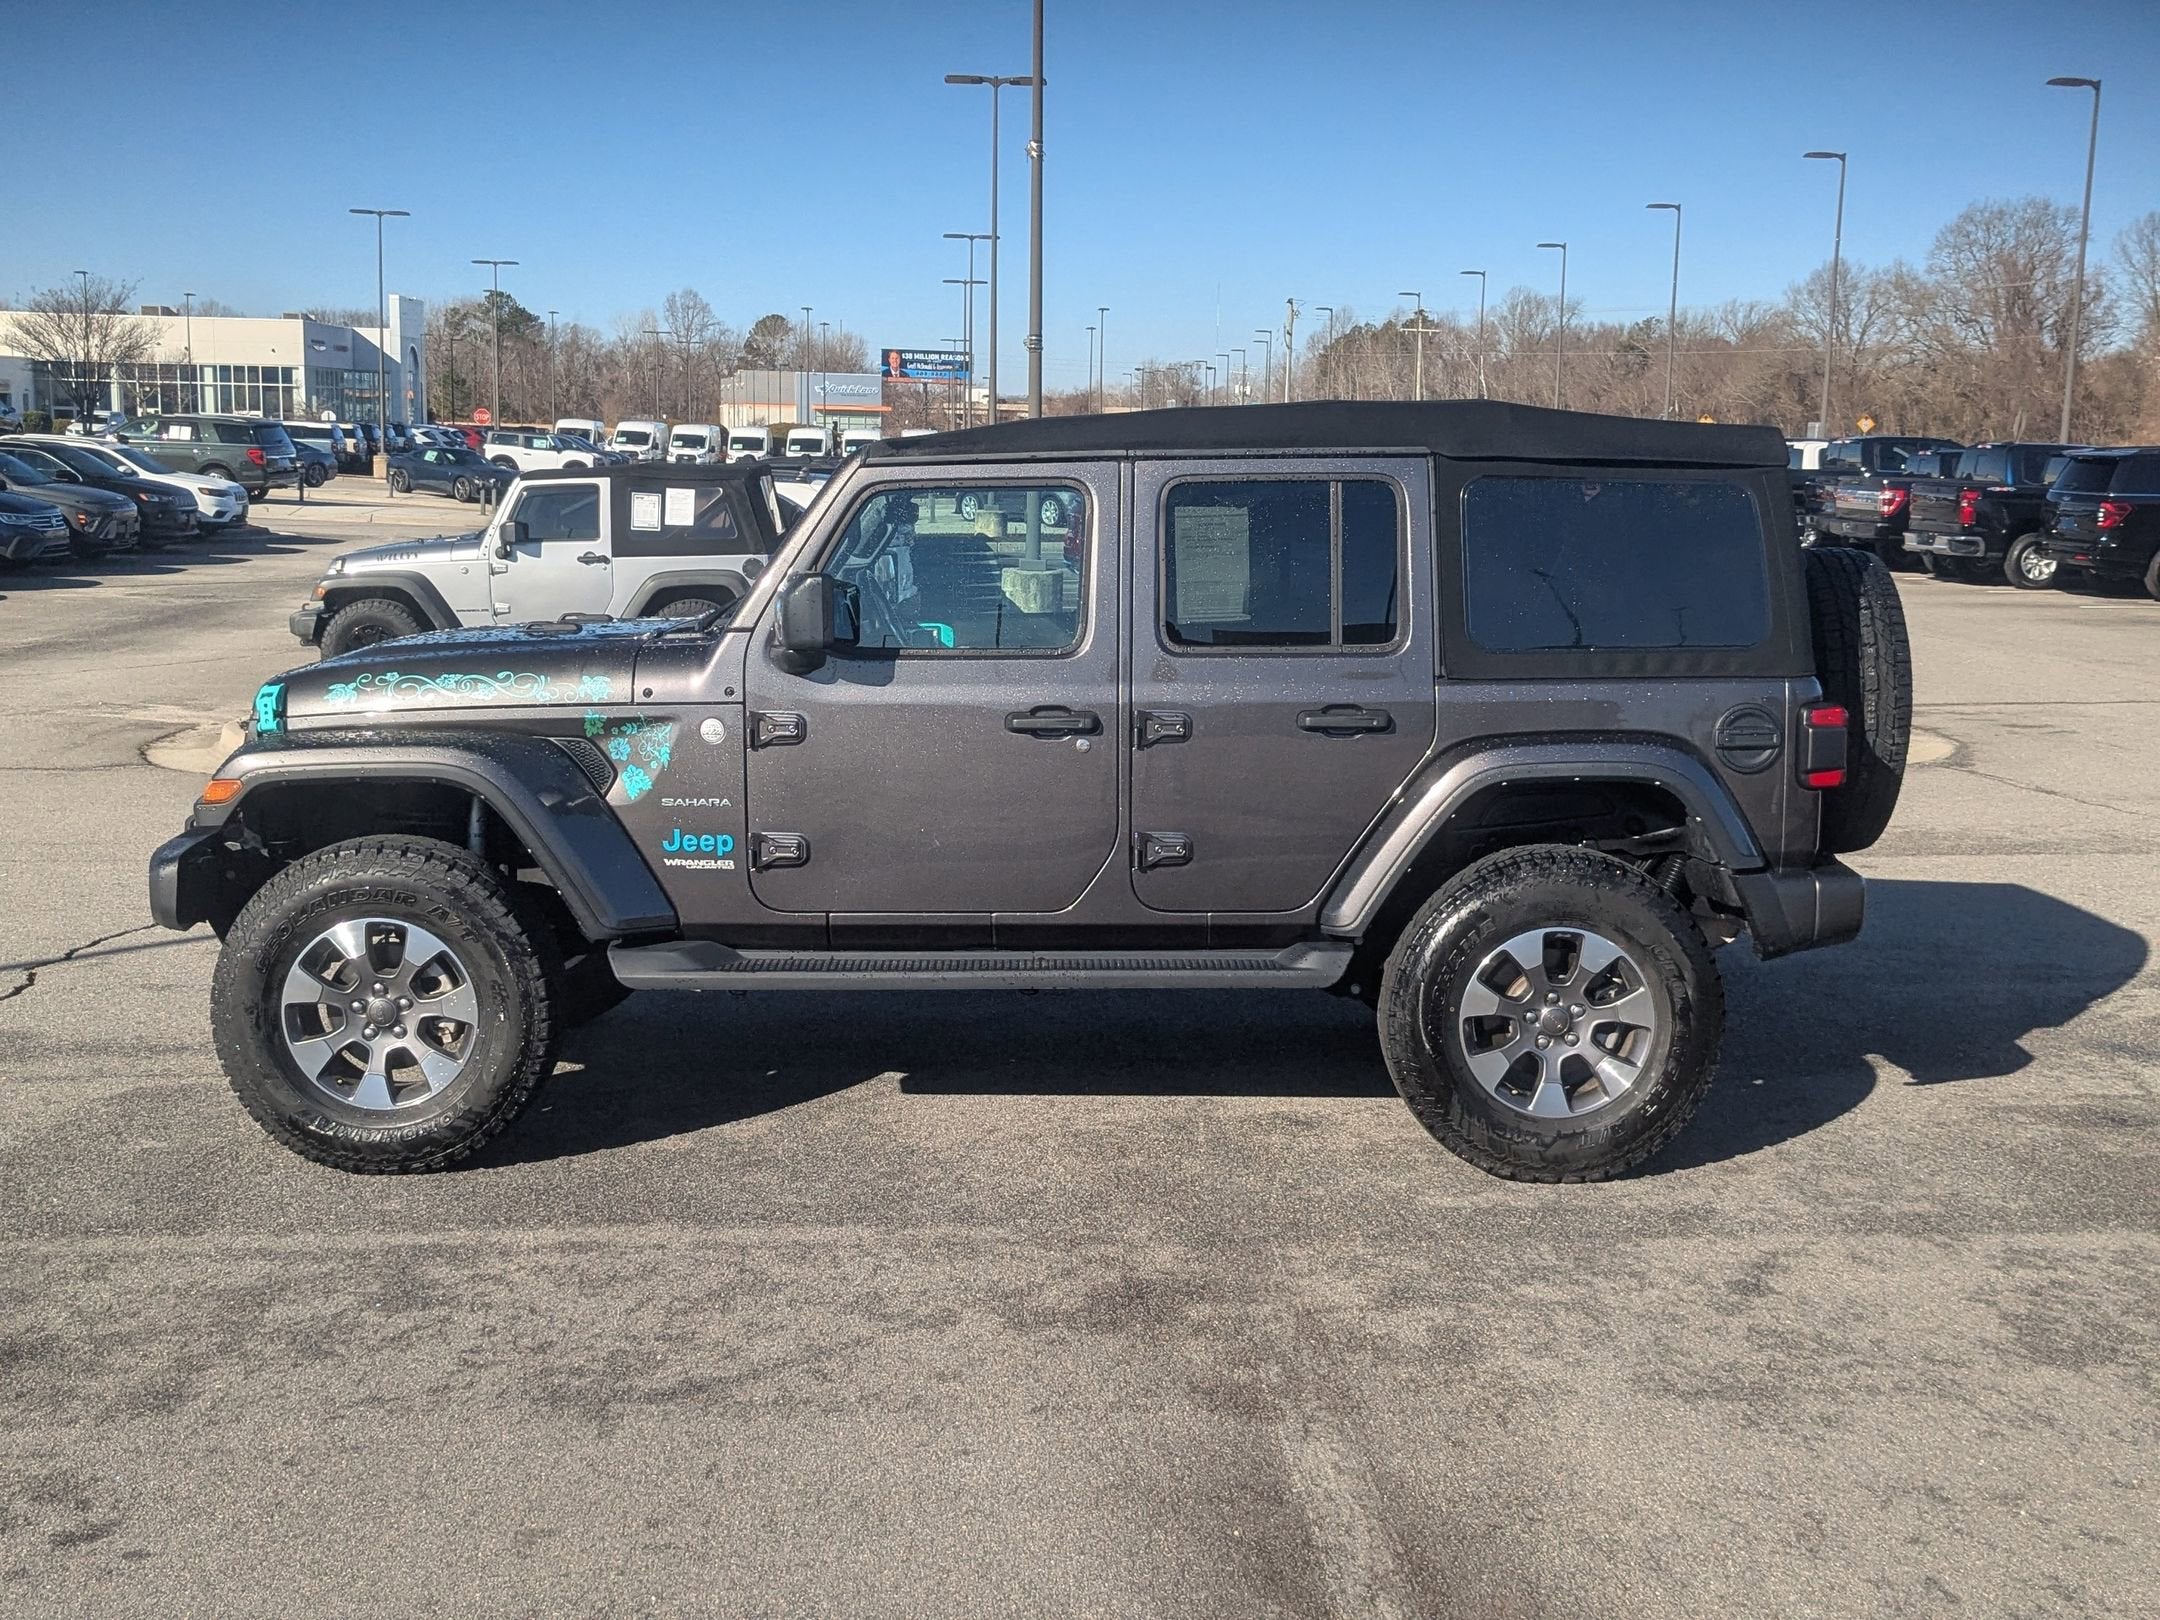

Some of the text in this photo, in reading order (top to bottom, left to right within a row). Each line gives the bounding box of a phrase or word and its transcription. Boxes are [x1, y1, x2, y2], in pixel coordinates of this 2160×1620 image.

[914, 353, 940, 361] MILLION
[475, 413, 490, 421] STOP
[661, 798, 732, 807] SAHARA
[662, 828, 734, 857] Jeep
[663, 858, 735, 866] WRANGLER
